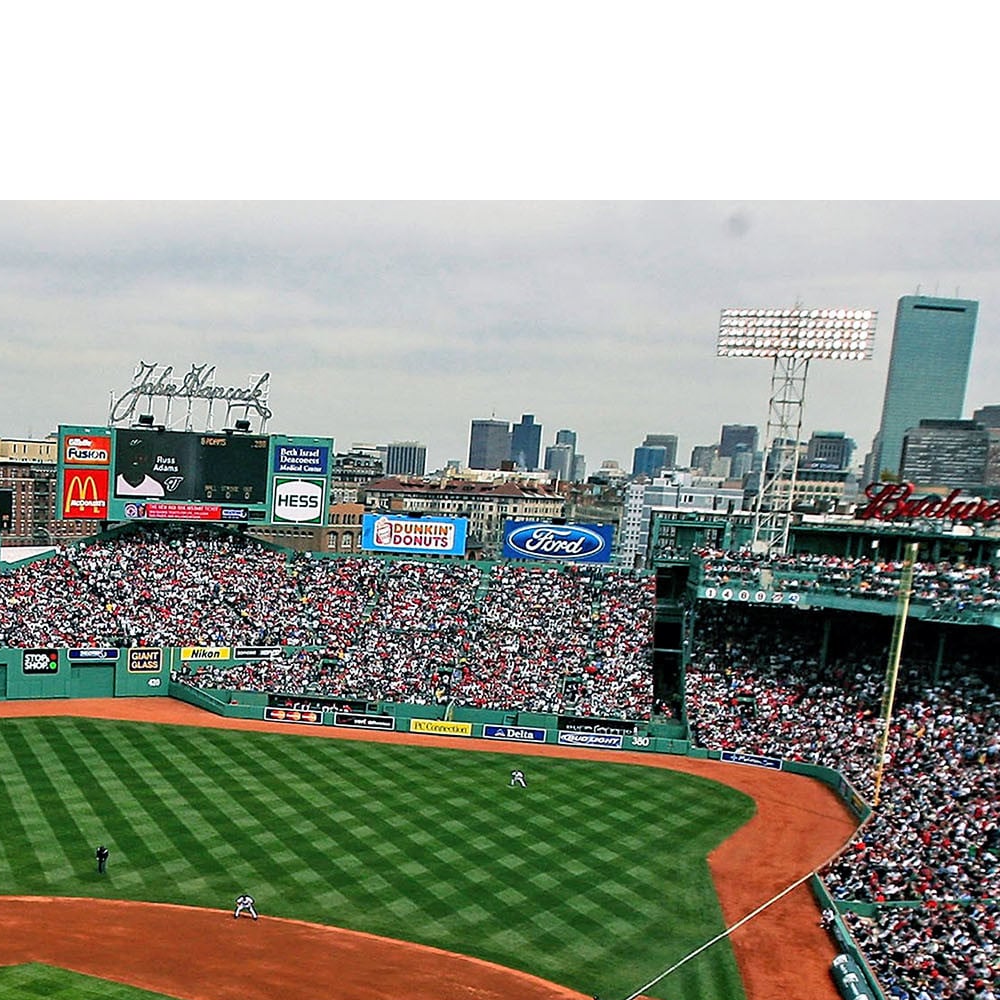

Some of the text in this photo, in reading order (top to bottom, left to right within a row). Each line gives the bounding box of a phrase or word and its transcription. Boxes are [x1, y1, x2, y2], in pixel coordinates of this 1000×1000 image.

[111, 361, 272, 421] John Hancock
[68, 448, 106, 460] Fusion
[280, 448, 320, 457] Beth Israel
[152, 464, 179, 472] Adams
[277, 494, 318, 508] HESS
[394, 535, 449, 548] DONUTS
[525, 527, 583, 554] Ford
[131, 652, 159, 660] GIANT
[191, 649, 221, 658] Nikon
[131, 661, 159, 669] GLASS
[426, 721, 468, 734] Connection
[507, 729, 534, 739] Delta
